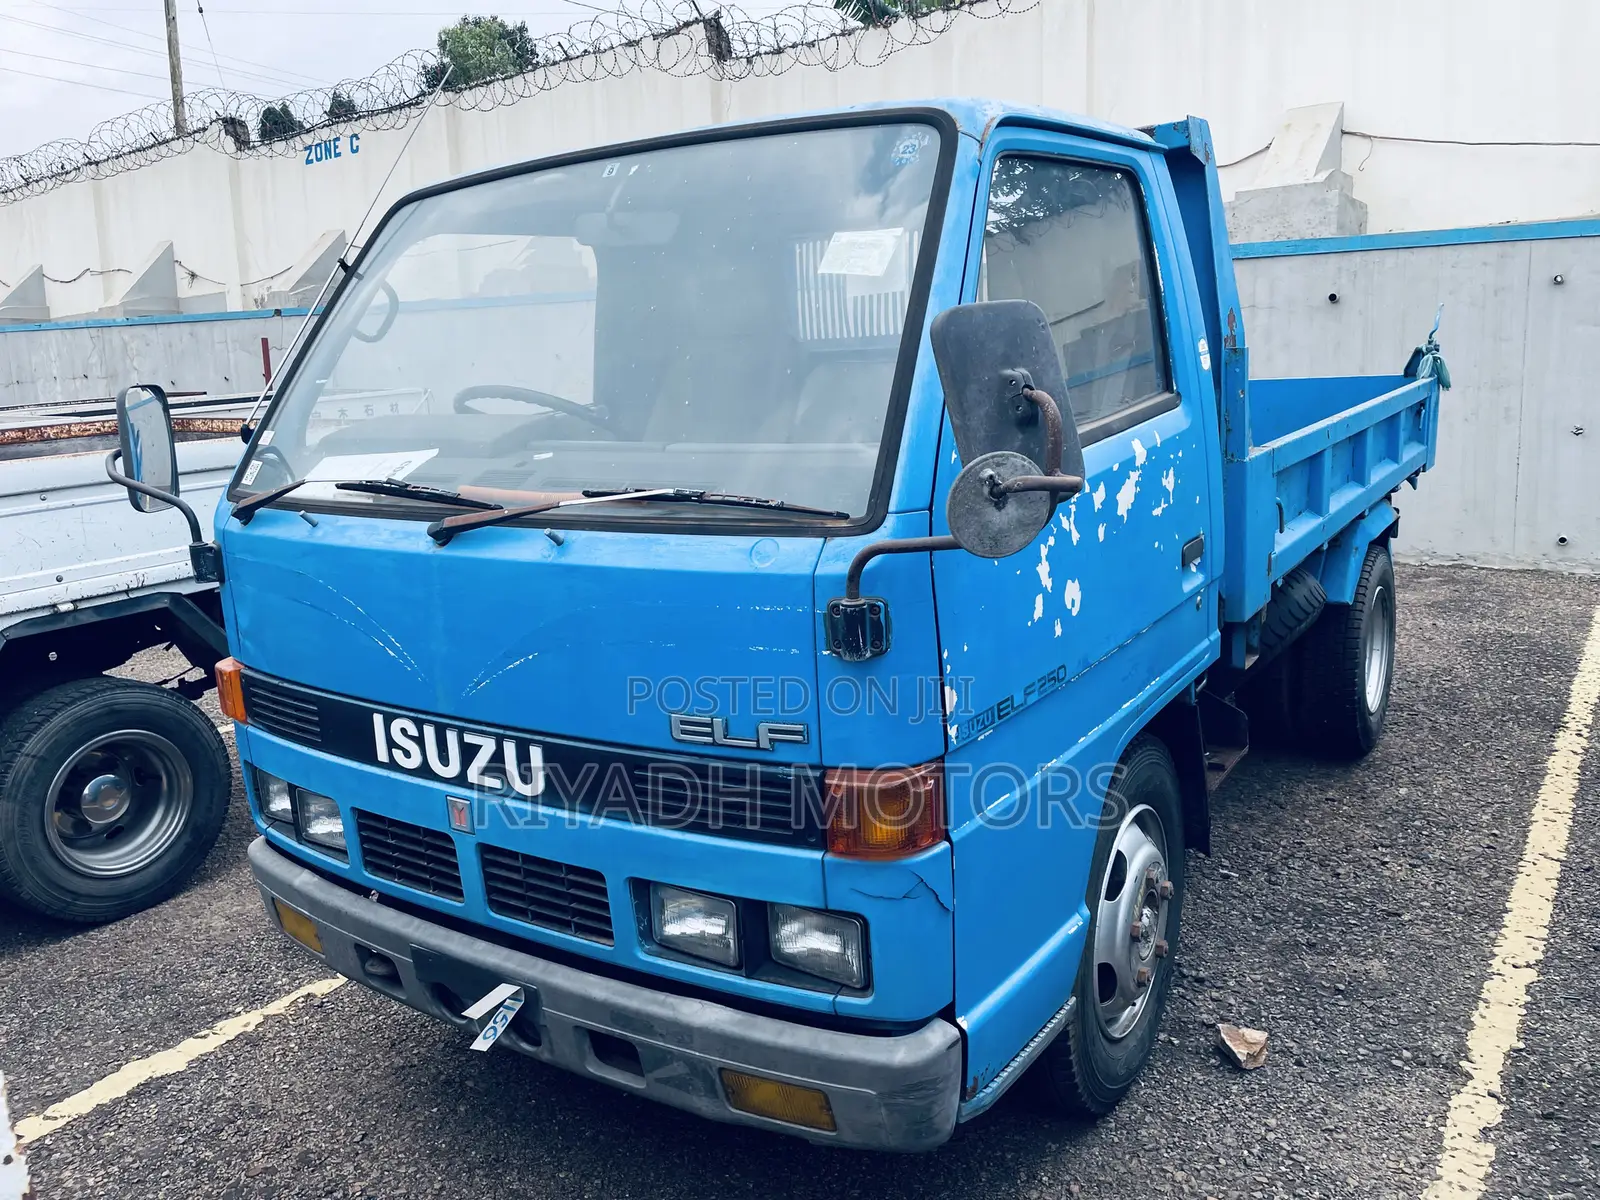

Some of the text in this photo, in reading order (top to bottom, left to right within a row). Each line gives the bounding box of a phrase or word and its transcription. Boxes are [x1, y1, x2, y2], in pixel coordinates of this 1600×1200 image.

[304, 133, 360, 165] ZONE C
[671, 713, 808, 750] ELF
[373, 712, 545, 796] ISUZU
